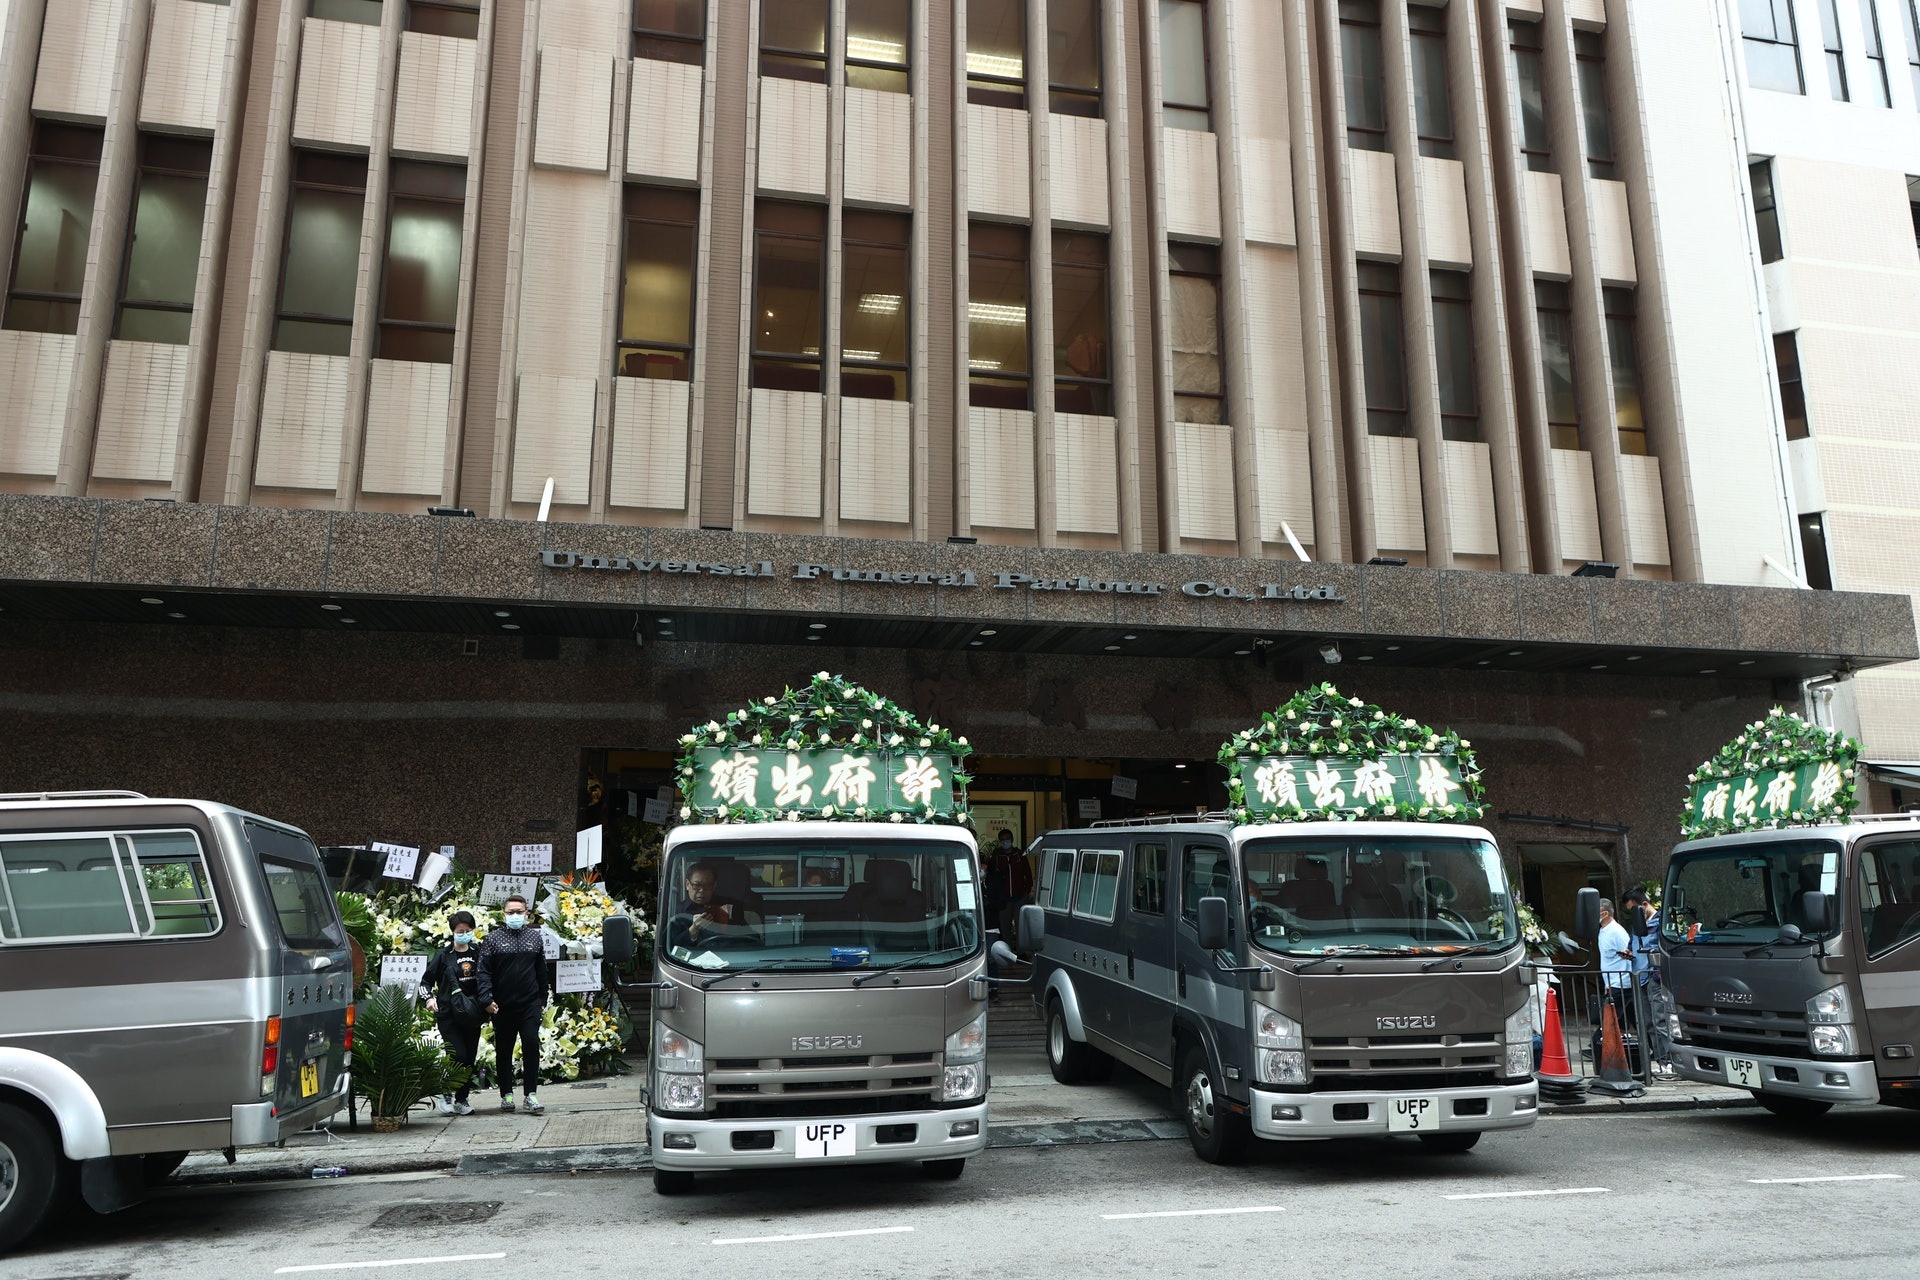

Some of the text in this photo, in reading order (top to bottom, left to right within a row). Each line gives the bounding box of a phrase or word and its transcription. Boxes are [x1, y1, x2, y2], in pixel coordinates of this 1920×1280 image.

[538, 550, 775, 578] Universal
[792, 562, 979, 587] Funeral
[993, 571, 1168, 596] Parlour
[1713, 991, 1753, 1004] ISUZU
[1376, 1015, 1436, 1031] ISUZU
[791, 1034, 863, 1051] ISUZU
[304, 1064, 315, 1081] UFP
[1730, 1058, 1753, 1073] UFP
[1740, 1072, 1748, 1085] 2
[1396, 1099, 1431, 1114] UFP
[1409, 1114, 1419, 1129] 3
[806, 1124, 847, 1141] UFP
